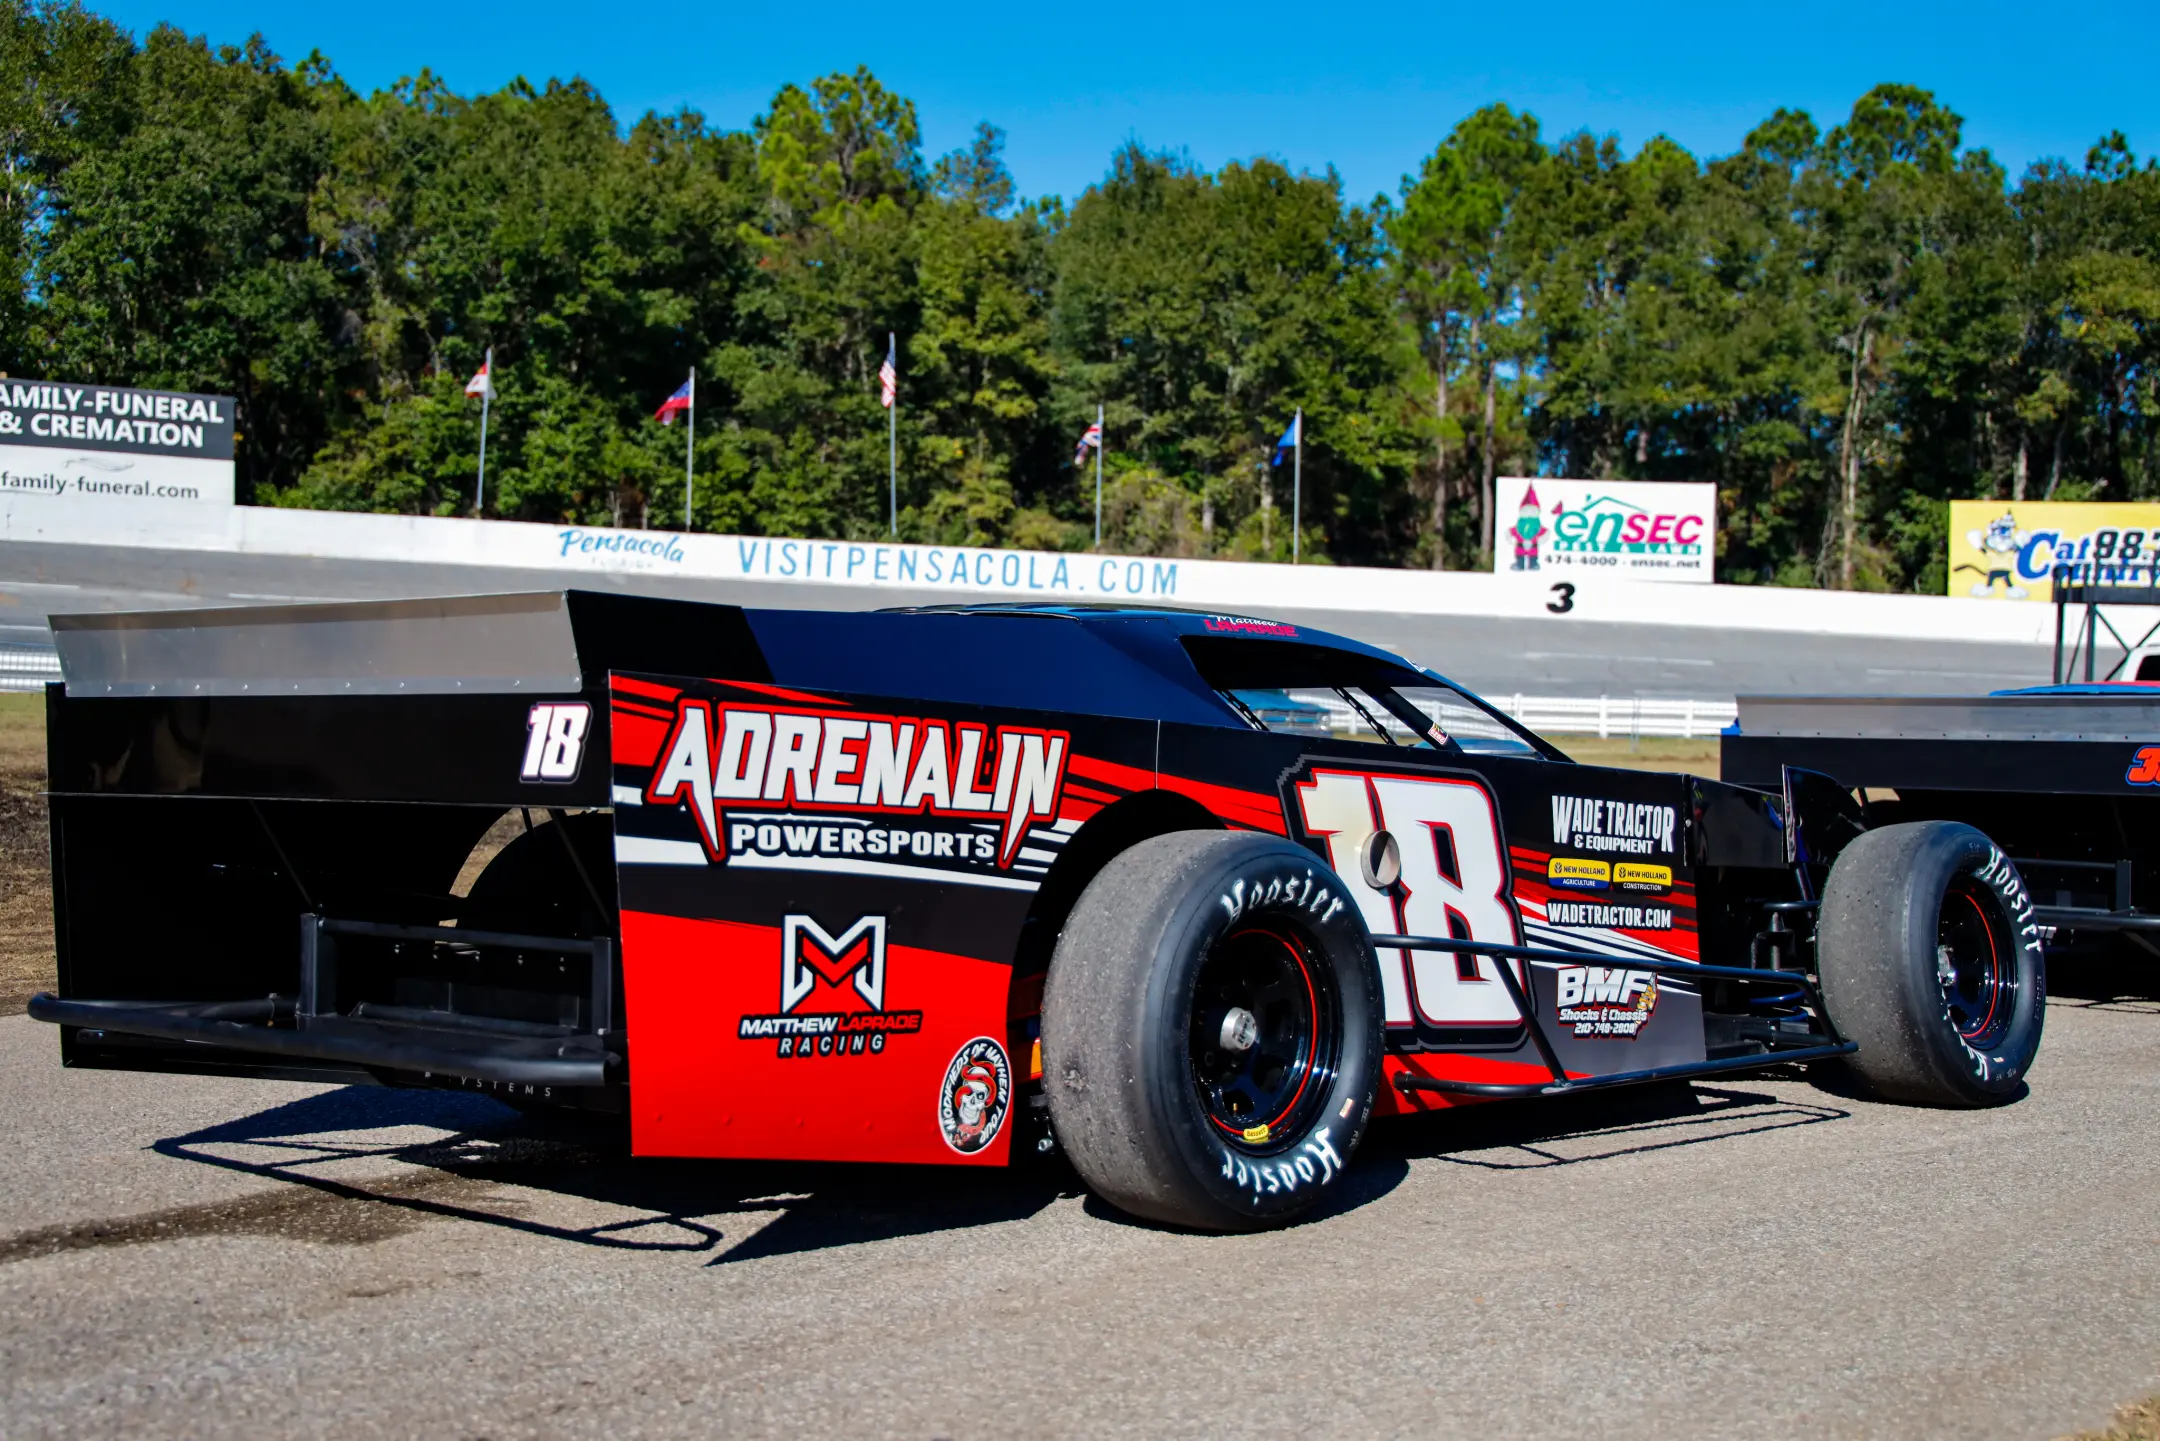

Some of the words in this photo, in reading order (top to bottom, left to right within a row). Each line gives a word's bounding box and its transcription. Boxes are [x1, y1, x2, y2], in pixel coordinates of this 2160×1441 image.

[0, 410, 23, 435] &
[30, 412, 203, 448] CREMATION
[0, 470, 199, 499] family-funeral.com
[559, 528, 685, 562] Pensacola
[1545, 581, 1576, 614] 3
[1208, 614, 1277, 627] Matthew
[521, 703, 590, 779] 18
[2127, 747, 2160, 783] 3
[654, 704, 1066, 864] ADRENALIN
[1551, 795, 1604, 844] WADE
[1606, 801, 1675, 853] TRACTOR
[730, 823, 996, 859] POWERSPORTS
[1573, 833, 1584, 848] &
[1585, 835, 1654, 854] EQUIPMENT
[1562, 878, 1596, 887] AGRICULTURE
[1563, 866, 1577, 874] NEW
[1578, 866, 1606, 876] HOLLAND
[1623, 882, 1662, 891] CONSTRUCTION
[1627, 870, 1641, 879] NEW
[1641, 871, 1667, 880] HOLLAND
[1220, 868, 1346, 927] Hoosier
[1295, 767, 1526, 1026] 18
[1547, 902, 1671, 929] WADETRACTOR.COM
[1557, 967, 1654, 1007] BMF
[1559, 1008, 1600, 1021] Shocks
[1600, 1007, 1608, 1023] &
[1608, 1009, 1648, 1021] Chassis
[780, 1034, 883, 1053] RACING
[971, 1042, 987, 1057] OF
[448, 1074, 552, 1097] YSTEMS
[943, 1047, 970, 1131] MODIFIEDS
[984, 1045, 1008, 1104] MAYHEM
[979, 1104, 1003, 1144] TOUR
